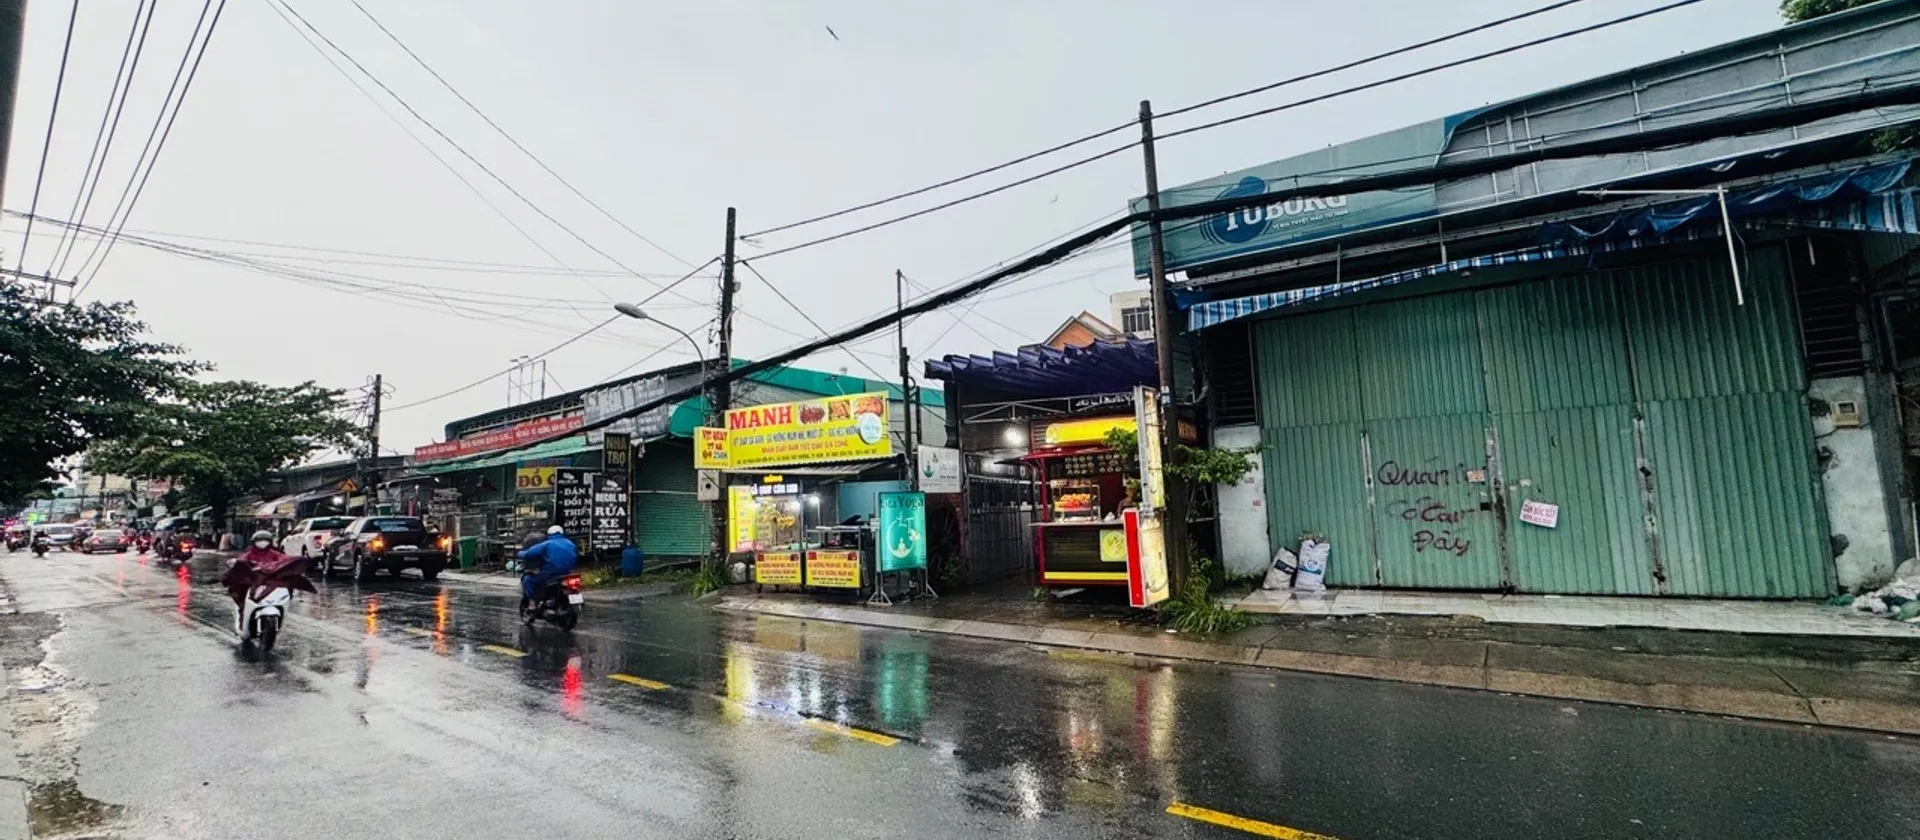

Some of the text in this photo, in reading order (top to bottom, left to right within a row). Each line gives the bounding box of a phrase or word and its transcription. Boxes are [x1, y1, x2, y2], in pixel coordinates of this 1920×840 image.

[1226, 195, 1347, 231] TUBORG
[595, 503, 626, 516] RỬA
[599, 518, 619, 528] XE
